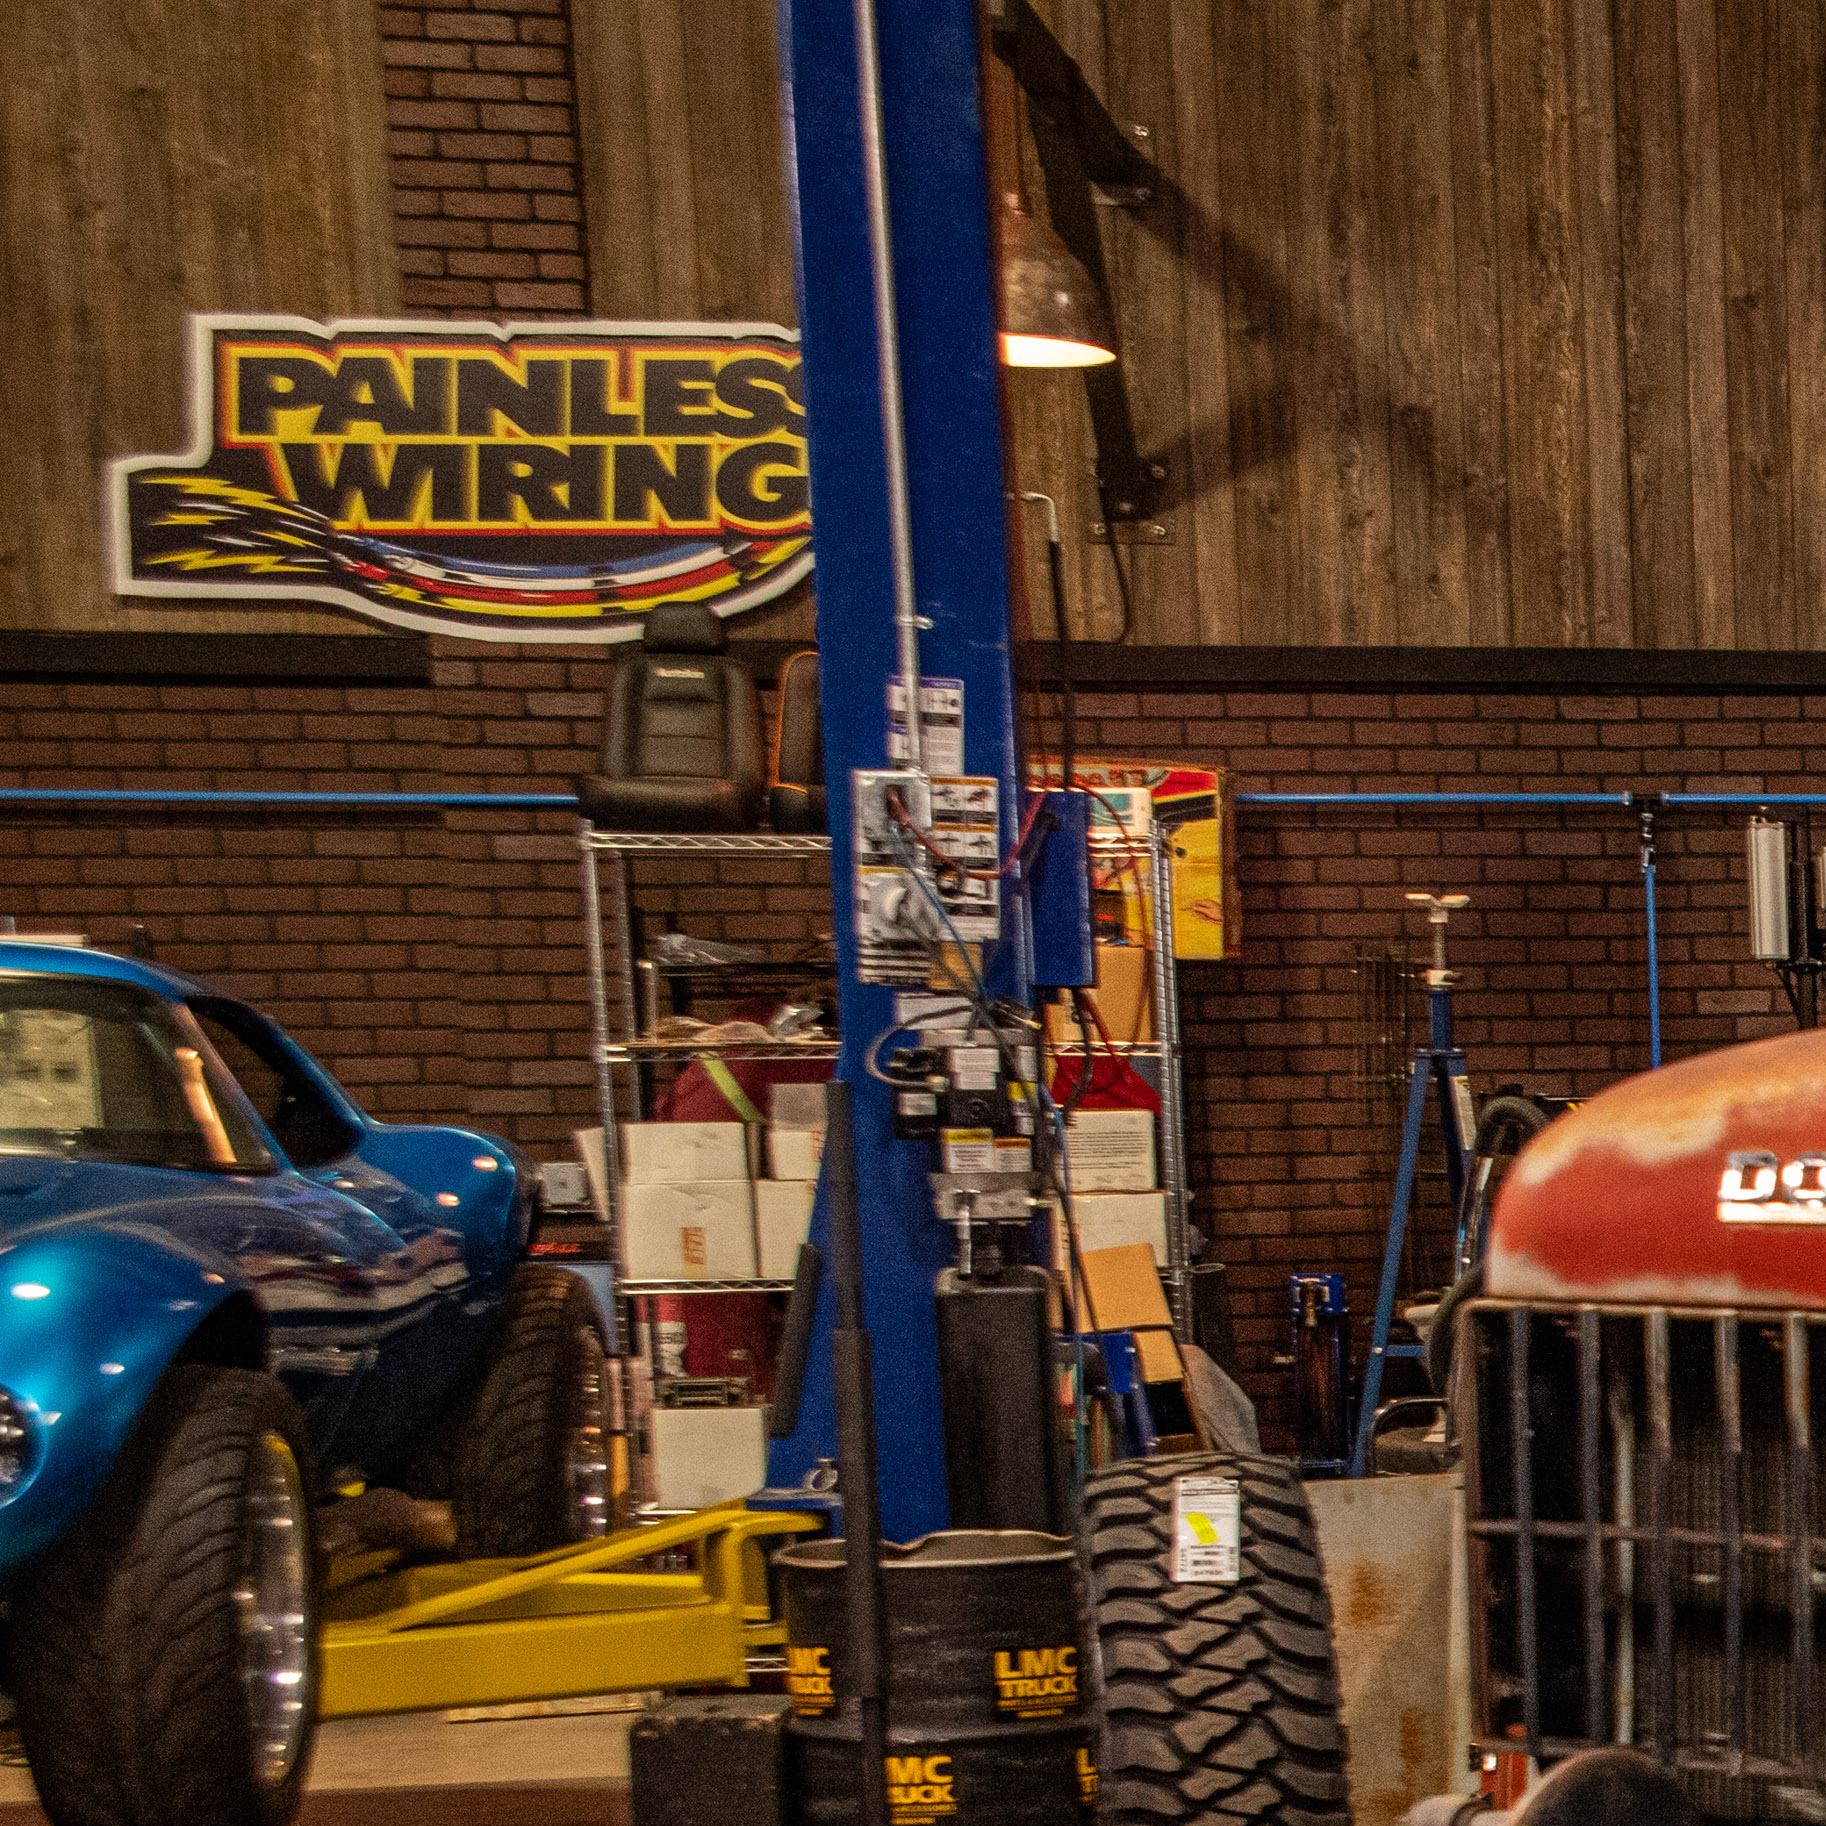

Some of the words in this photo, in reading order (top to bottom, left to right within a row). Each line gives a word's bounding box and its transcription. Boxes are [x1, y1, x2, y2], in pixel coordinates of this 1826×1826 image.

[287, 442, 810, 522] WIRING
[994, 1646, 1078, 1679] LMC
[994, 1675, 1079, 1698] TRUCK
[884, 1754, 953, 1784] MC
